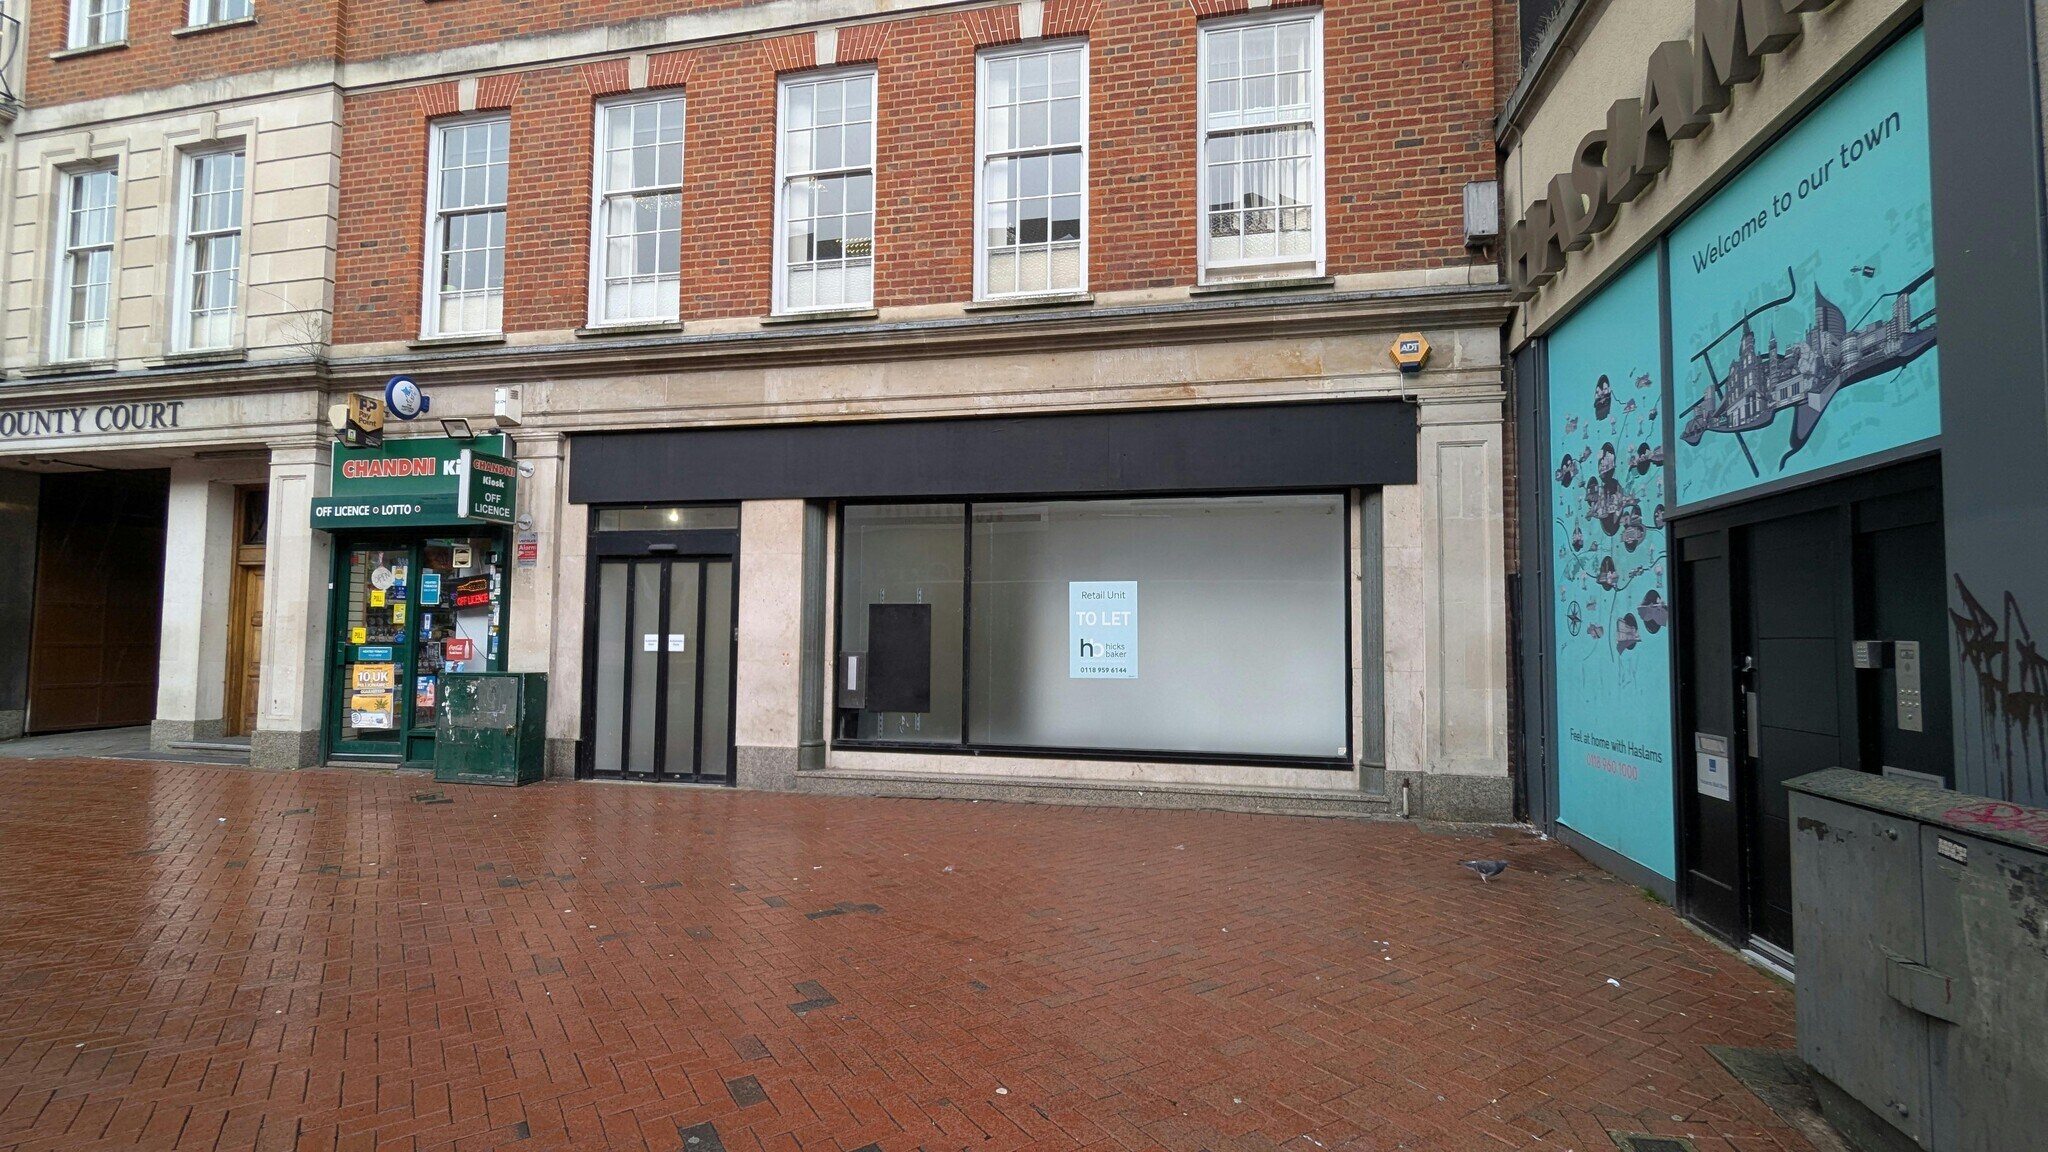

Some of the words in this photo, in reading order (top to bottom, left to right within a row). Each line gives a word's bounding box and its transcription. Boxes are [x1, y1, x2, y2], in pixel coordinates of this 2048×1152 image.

[1510, 0, 1836, 303] HASLAM
[1692, 210, 1767, 274] Welcome
[1773, 192, 1792, 218] to
[1798, 159, 1834, 199] our
[1840, 111, 1900, 169] town
[1400, 343, 1419, 351] ADT
[0, 407, 87, 437] OUNTY
[95, 401, 184, 431] COURT
[359, 411, 371, 420] Pay
[359, 417, 377, 427] Point
[343, 457, 436, 478] CHANDNI
[473, 459, 516, 478] CHANDNI
[482, 476, 505, 489] Kiosk
[484, 493, 502, 504] OFF
[316, 506, 332, 517] OFF
[334, 505, 370, 517] LICENCE
[382, 505, 412, 516] LOTTO
[475, 503, 511, 518] LICENCE
[375, 571, 391, 584] OPEN
[457, 596, 468, 606] OFF
[468, 593, 489, 605] LICENCE
[1082, 591, 1106, 600] Retail
[1107, 591, 1126, 600] Unit
[1076, 611, 1097, 626] TO
[1102, 611, 1132, 626] LET
[1105, 650, 1127, 658] baker
[358, 671, 371, 682] 10
[372, 671, 389, 682] UK
[1570, 728, 1583, 743] Feel
[1584, 732, 1591, 745] at
[1591, 732, 1610, 750] home
[1611, 739, 1627, 754] with
[1628, 740, 1663, 763] Haslams
[1587, 752, 1601, 769] 0118
[1603, 757, 1617, 774] 960
[1619, 762, 1639, 781] 1000
